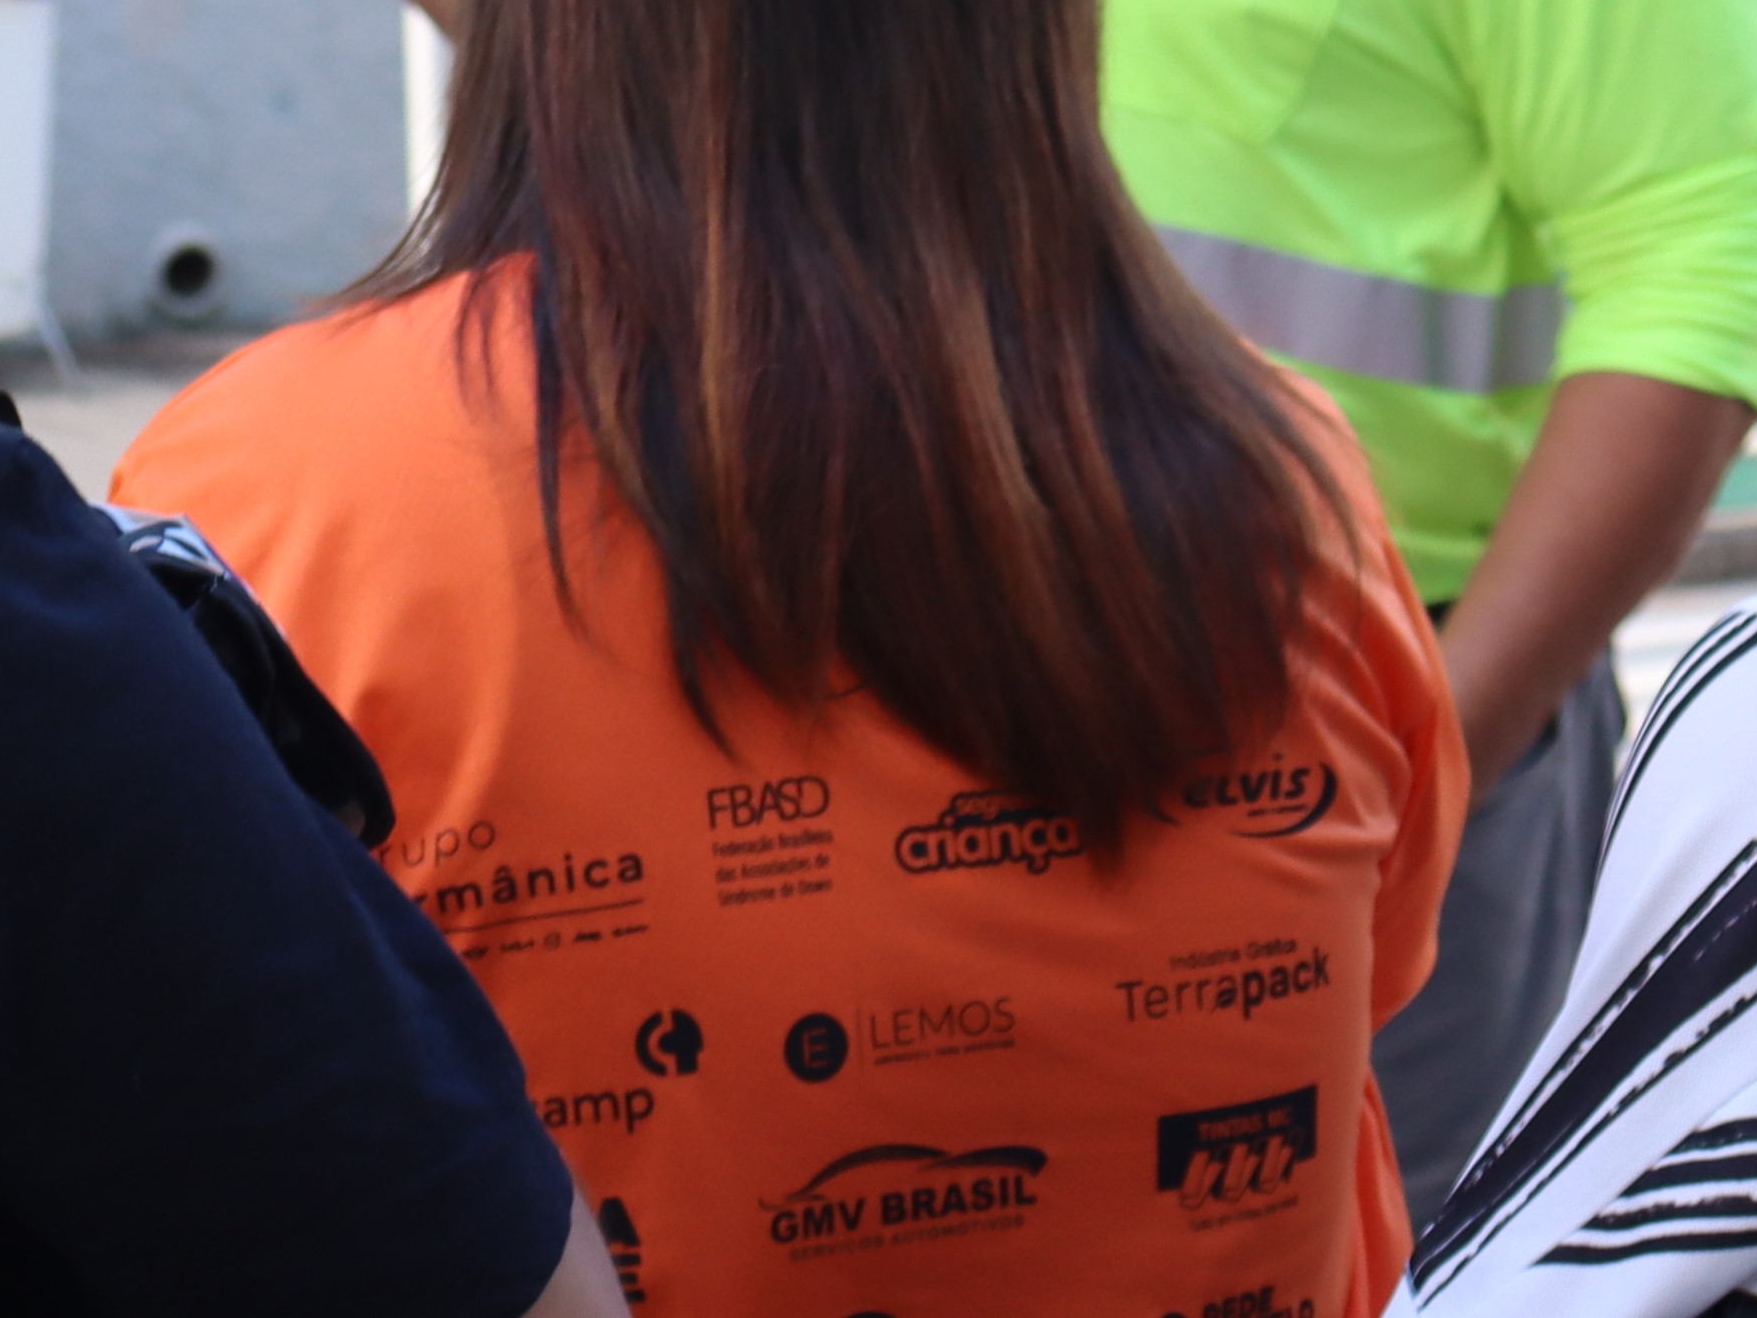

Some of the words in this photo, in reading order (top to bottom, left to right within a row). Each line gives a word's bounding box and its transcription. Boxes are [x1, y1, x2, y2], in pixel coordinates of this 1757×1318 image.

[707, 774, 831, 830] FBASD
[378, 820, 496, 869] rupo
[898, 815, 1081, 872] criança
[414, 851, 644, 914] mânica
[1114, 946, 1331, 1023] Terrapack
[870, 996, 1016, 1050] LEMOS
[538, 1087, 655, 1135] amp
[770, 1197, 867, 1244] GMV
[880, 1175, 1038, 1226] BRASIL
